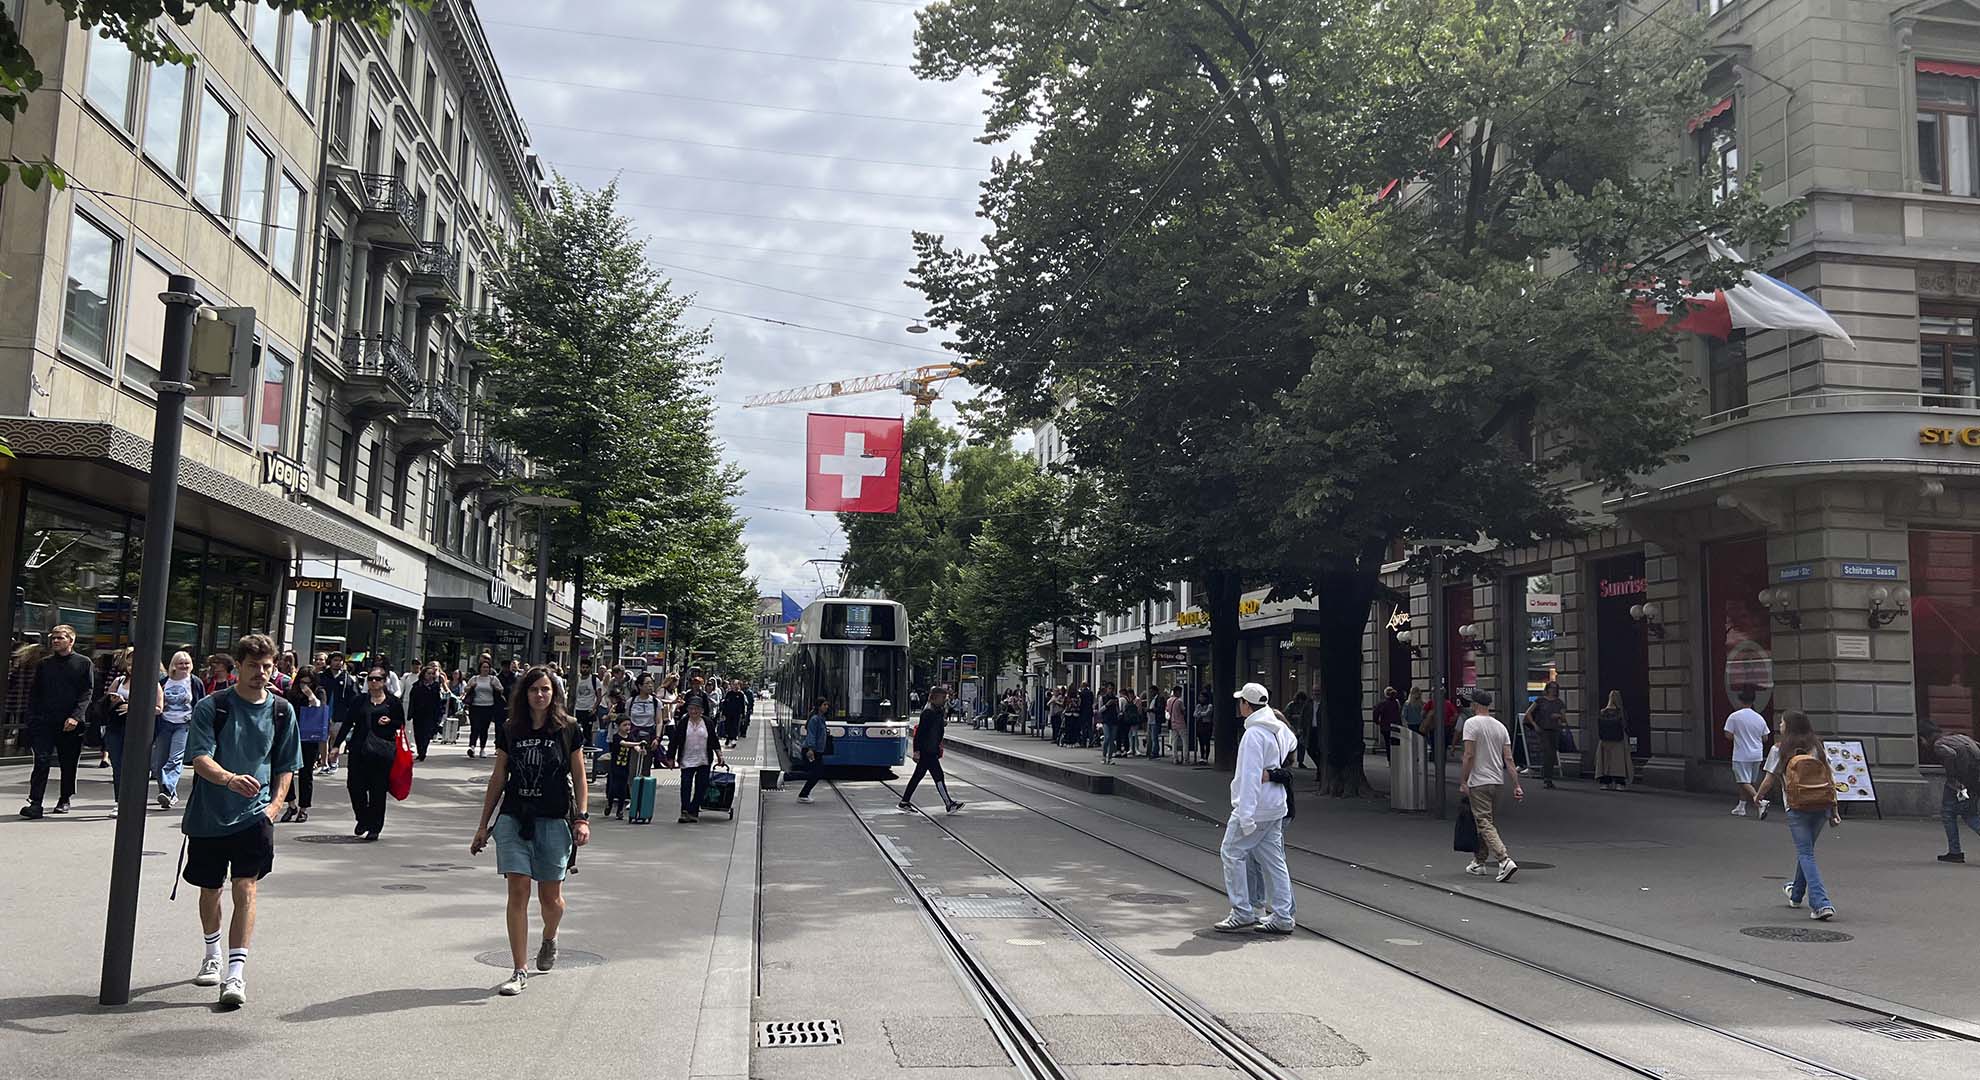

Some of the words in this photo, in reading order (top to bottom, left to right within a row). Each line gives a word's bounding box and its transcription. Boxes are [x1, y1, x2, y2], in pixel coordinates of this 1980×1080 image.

[1600, 576, 1648, 597] Sunrise
[516, 739, 541, 748] KEEP
[544, 740, 555, 748] IT
[519, 788, 543, 797] REAL
